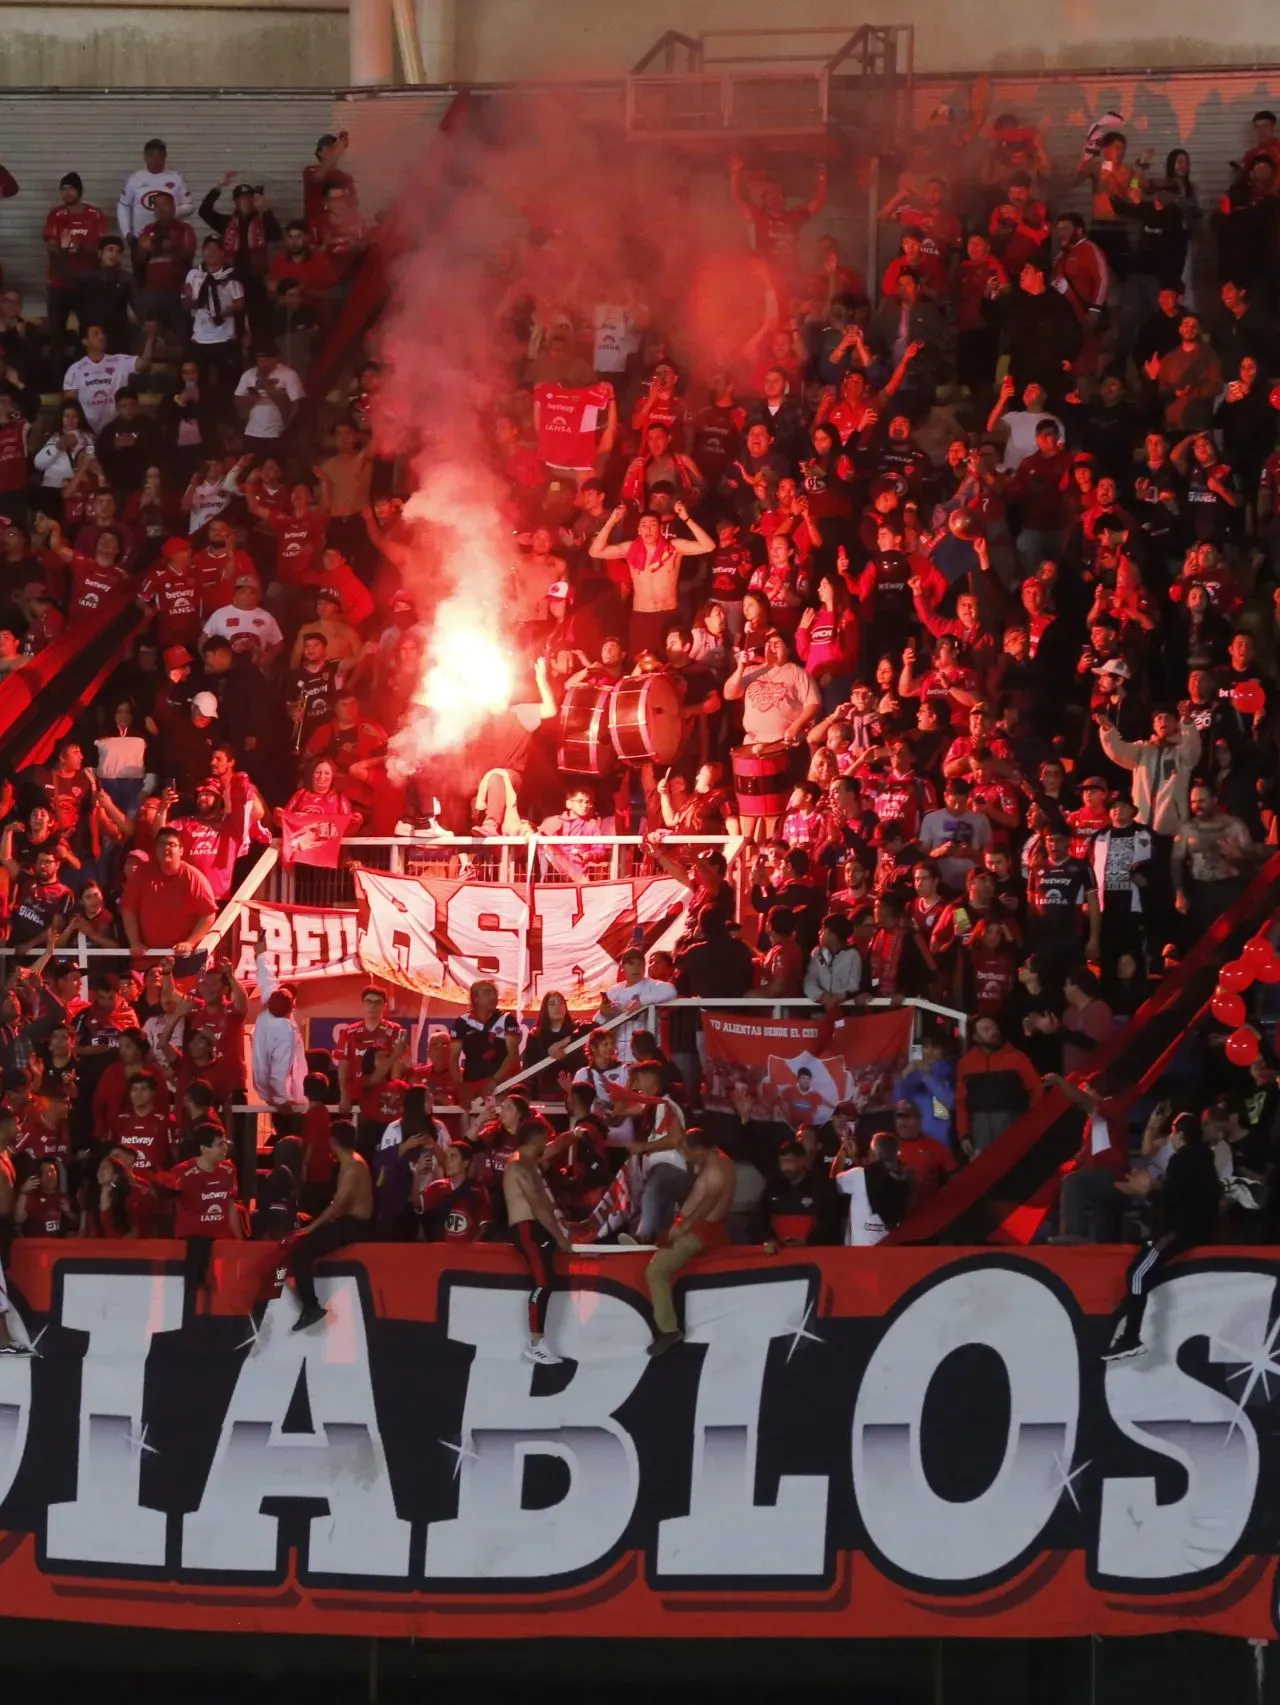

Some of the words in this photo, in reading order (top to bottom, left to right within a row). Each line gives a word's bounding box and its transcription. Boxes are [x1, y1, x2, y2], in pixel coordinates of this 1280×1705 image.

[85, 377, 112, 387] betway
[547, 403, 575, 414] betway
[85, 579, 111, 592] betway
[165, 589, 194, 599] betway
[1039, 877, 1071, 886] betway
[723, 1022, 762, 1036] ALIENTAS
[122, 1136, 154, 1145] betway
[202, 1191, 228, 1200] betway
